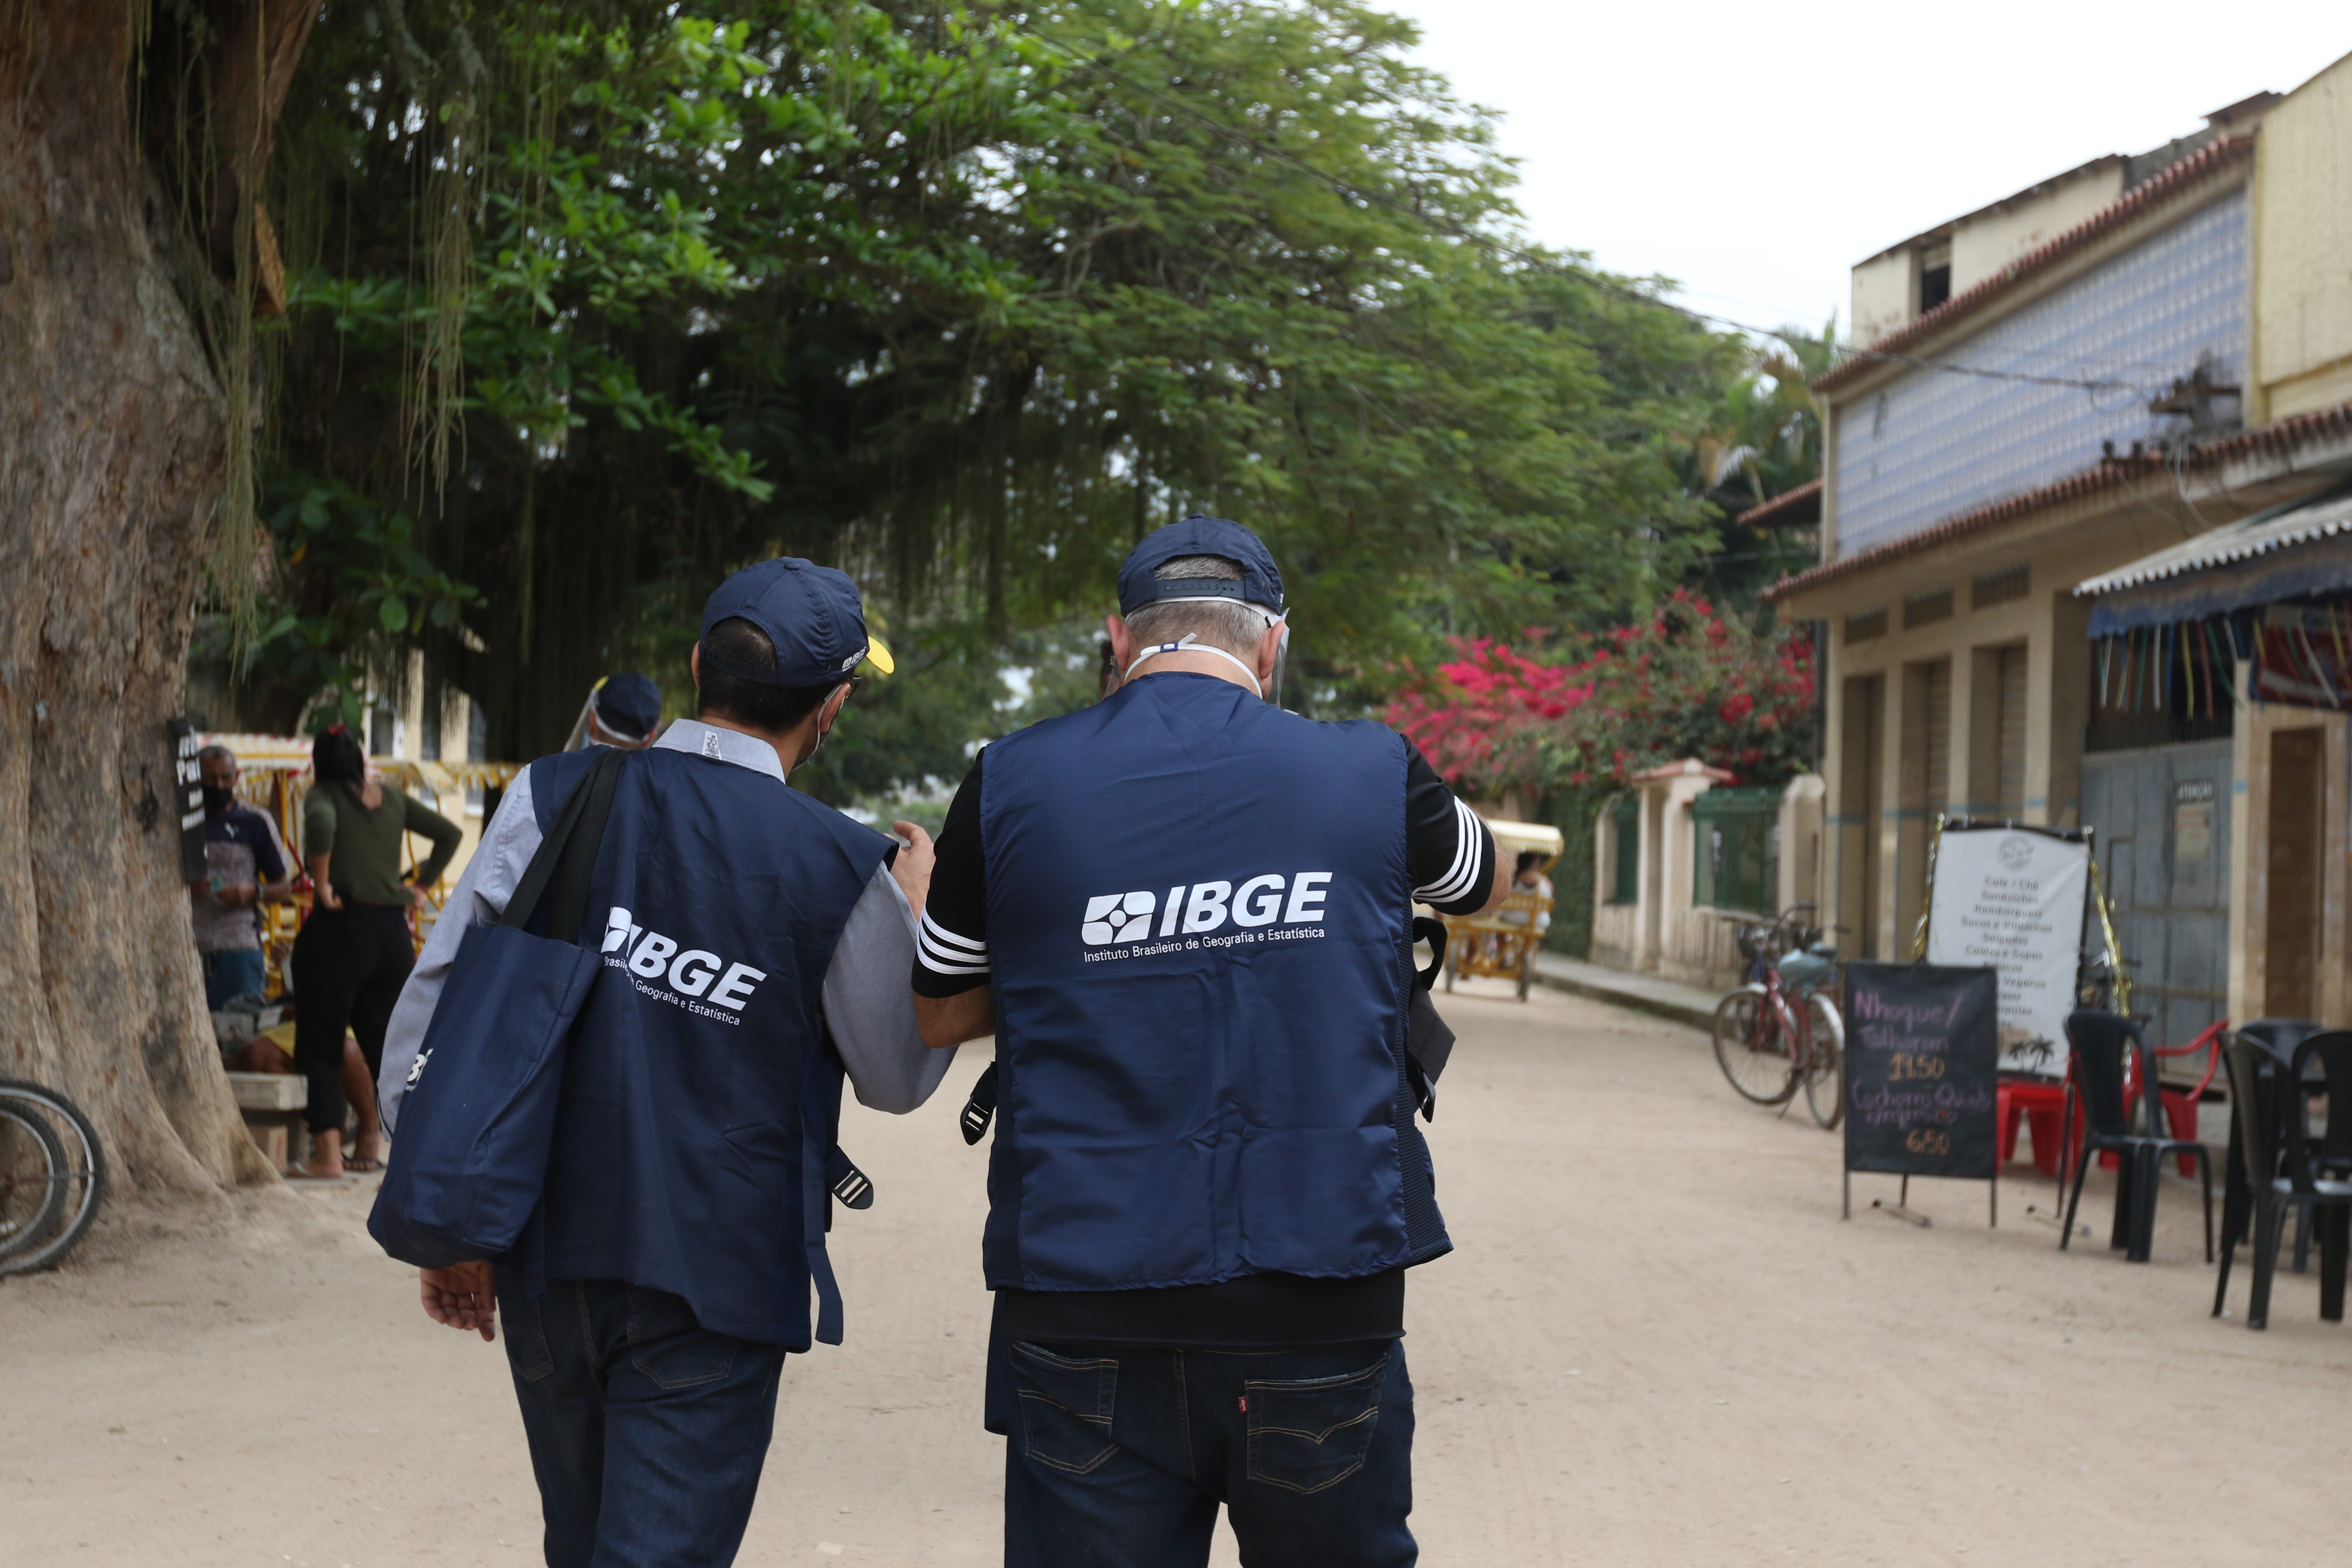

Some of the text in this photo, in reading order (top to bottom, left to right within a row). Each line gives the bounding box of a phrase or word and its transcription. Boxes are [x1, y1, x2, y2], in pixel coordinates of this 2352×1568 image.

[1159, 871, 1333, 937] IBGE
[1084, 926, 1325, 962] Instituto Brasileiro de Geografia e Estatística
[2004, 920, 2053, 933] Vitaminas
[635, 980, 679, 1006] Geografia
[680, 999, 686, 1008] e
[688, 1001, 740, 1026] Estatística
